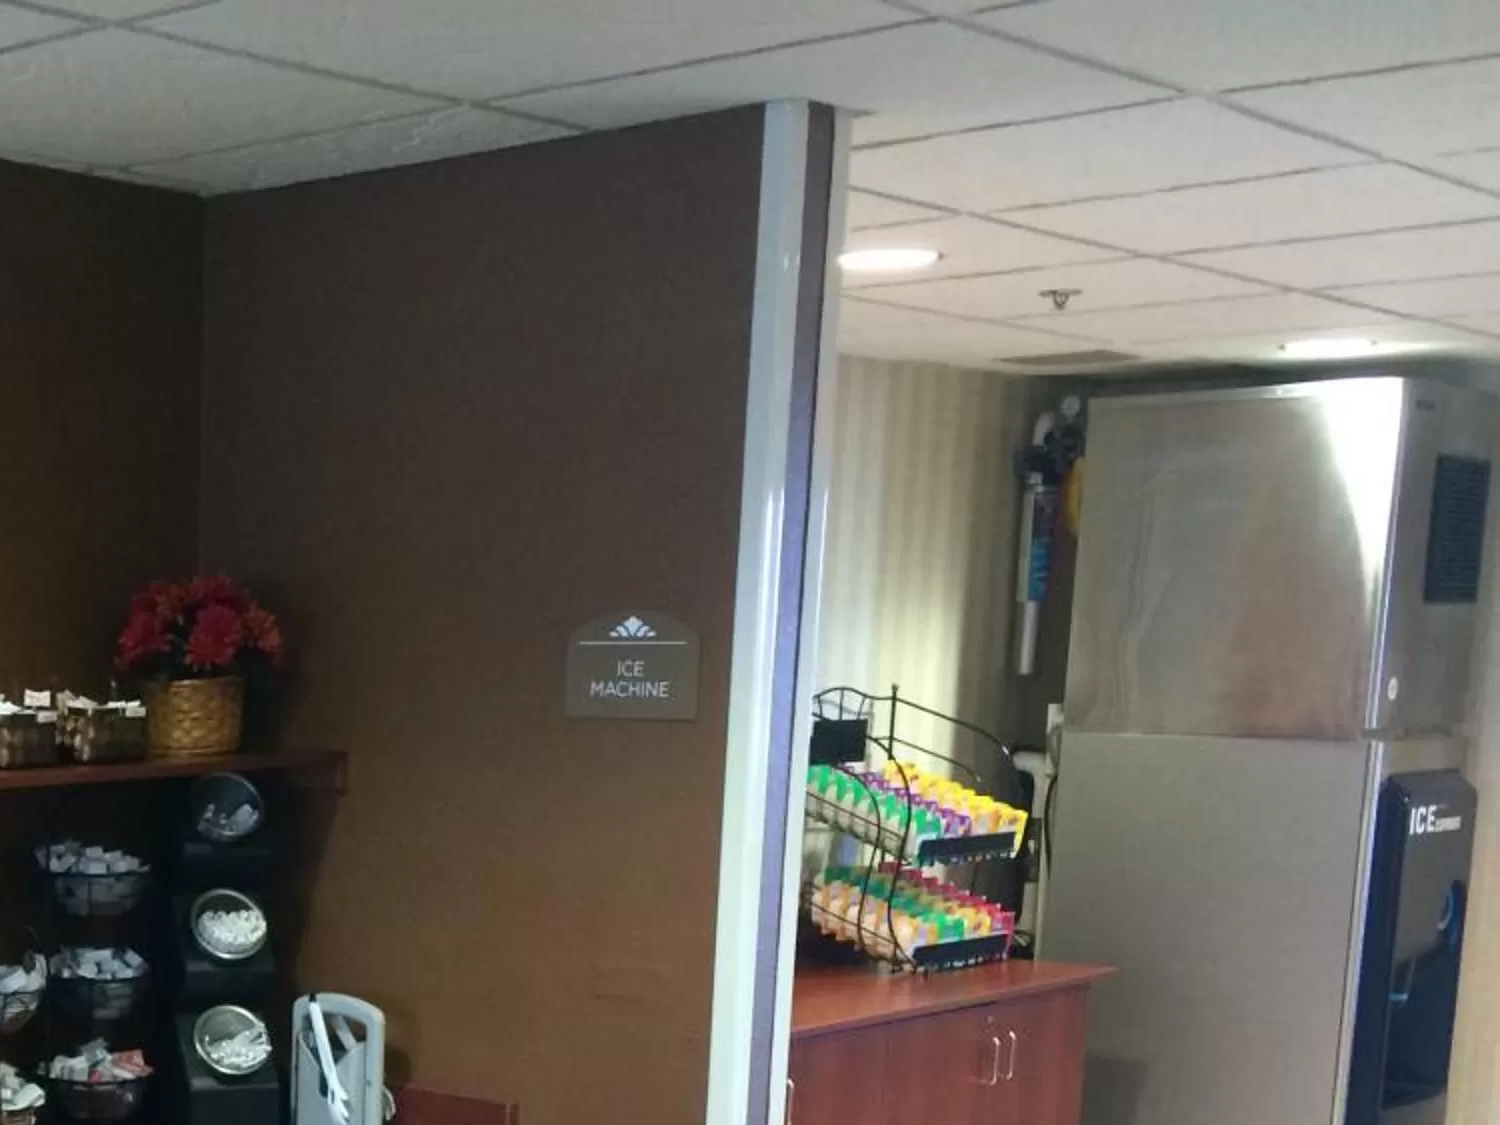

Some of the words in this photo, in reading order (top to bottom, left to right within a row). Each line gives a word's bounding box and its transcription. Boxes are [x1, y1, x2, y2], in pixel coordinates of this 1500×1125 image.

[616, 659, 645, 678] ICE
[589, 680, 670, 698] MACHINE
[1409, 804, 1437, 835] ICE
